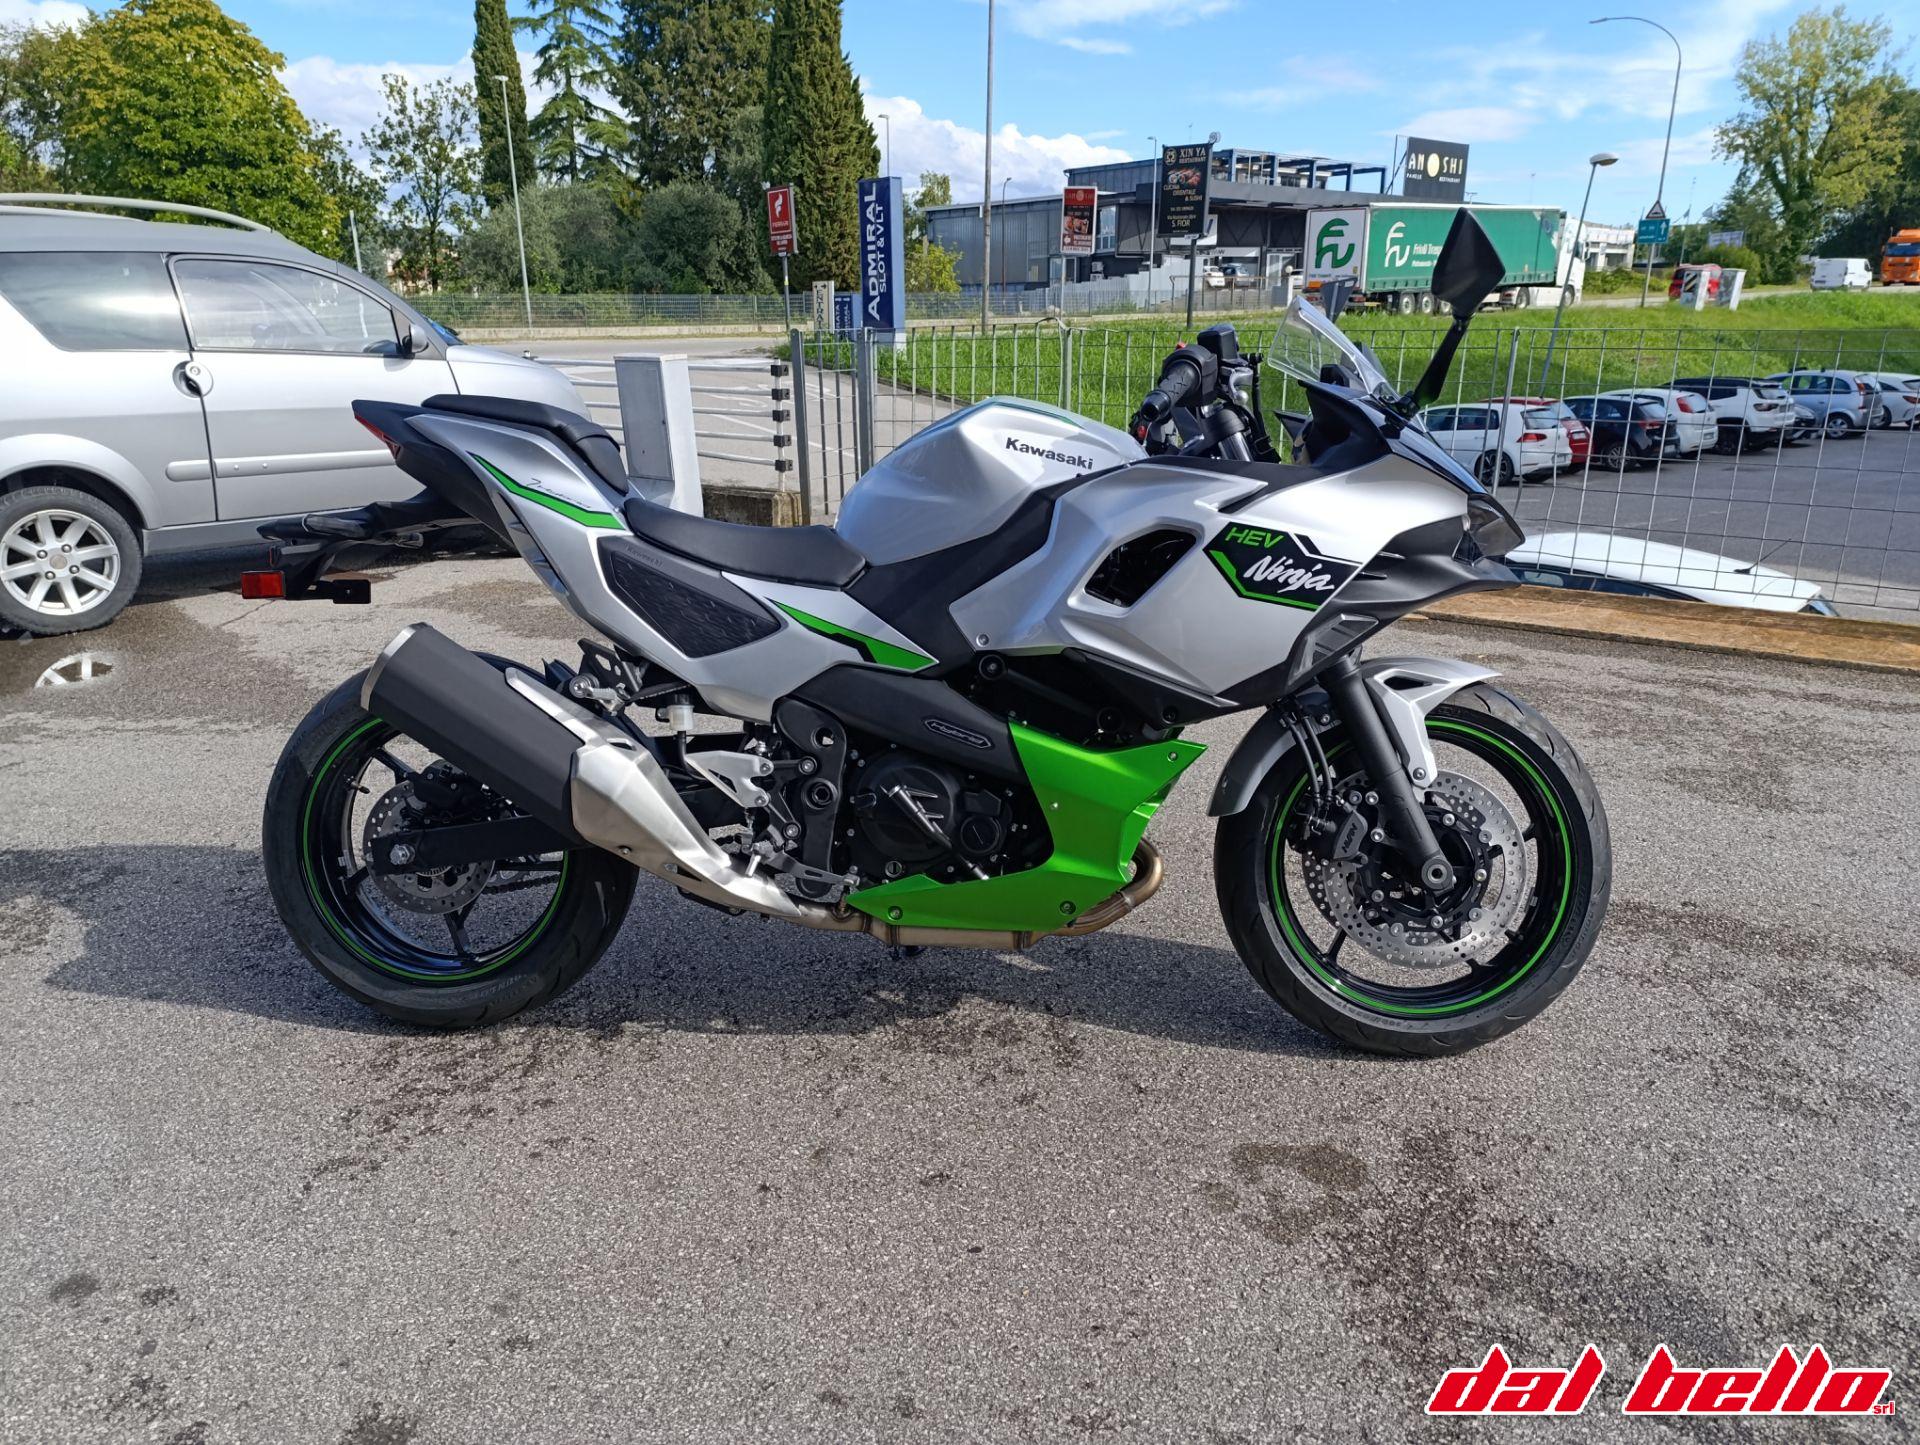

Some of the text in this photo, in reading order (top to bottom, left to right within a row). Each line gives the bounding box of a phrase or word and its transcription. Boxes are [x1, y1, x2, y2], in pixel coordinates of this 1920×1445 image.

[1179, 147, 1206, 158] XIN YA
[865, 182, 880, 321] ADMIRAL
[876, 203, 887, 293] SLOT & VLT
[1005, 437, 1093, 470] Kawasaki
[1225, 527, 1285, 548] HEV
[1243, 555, 1335, 593] Ninja
